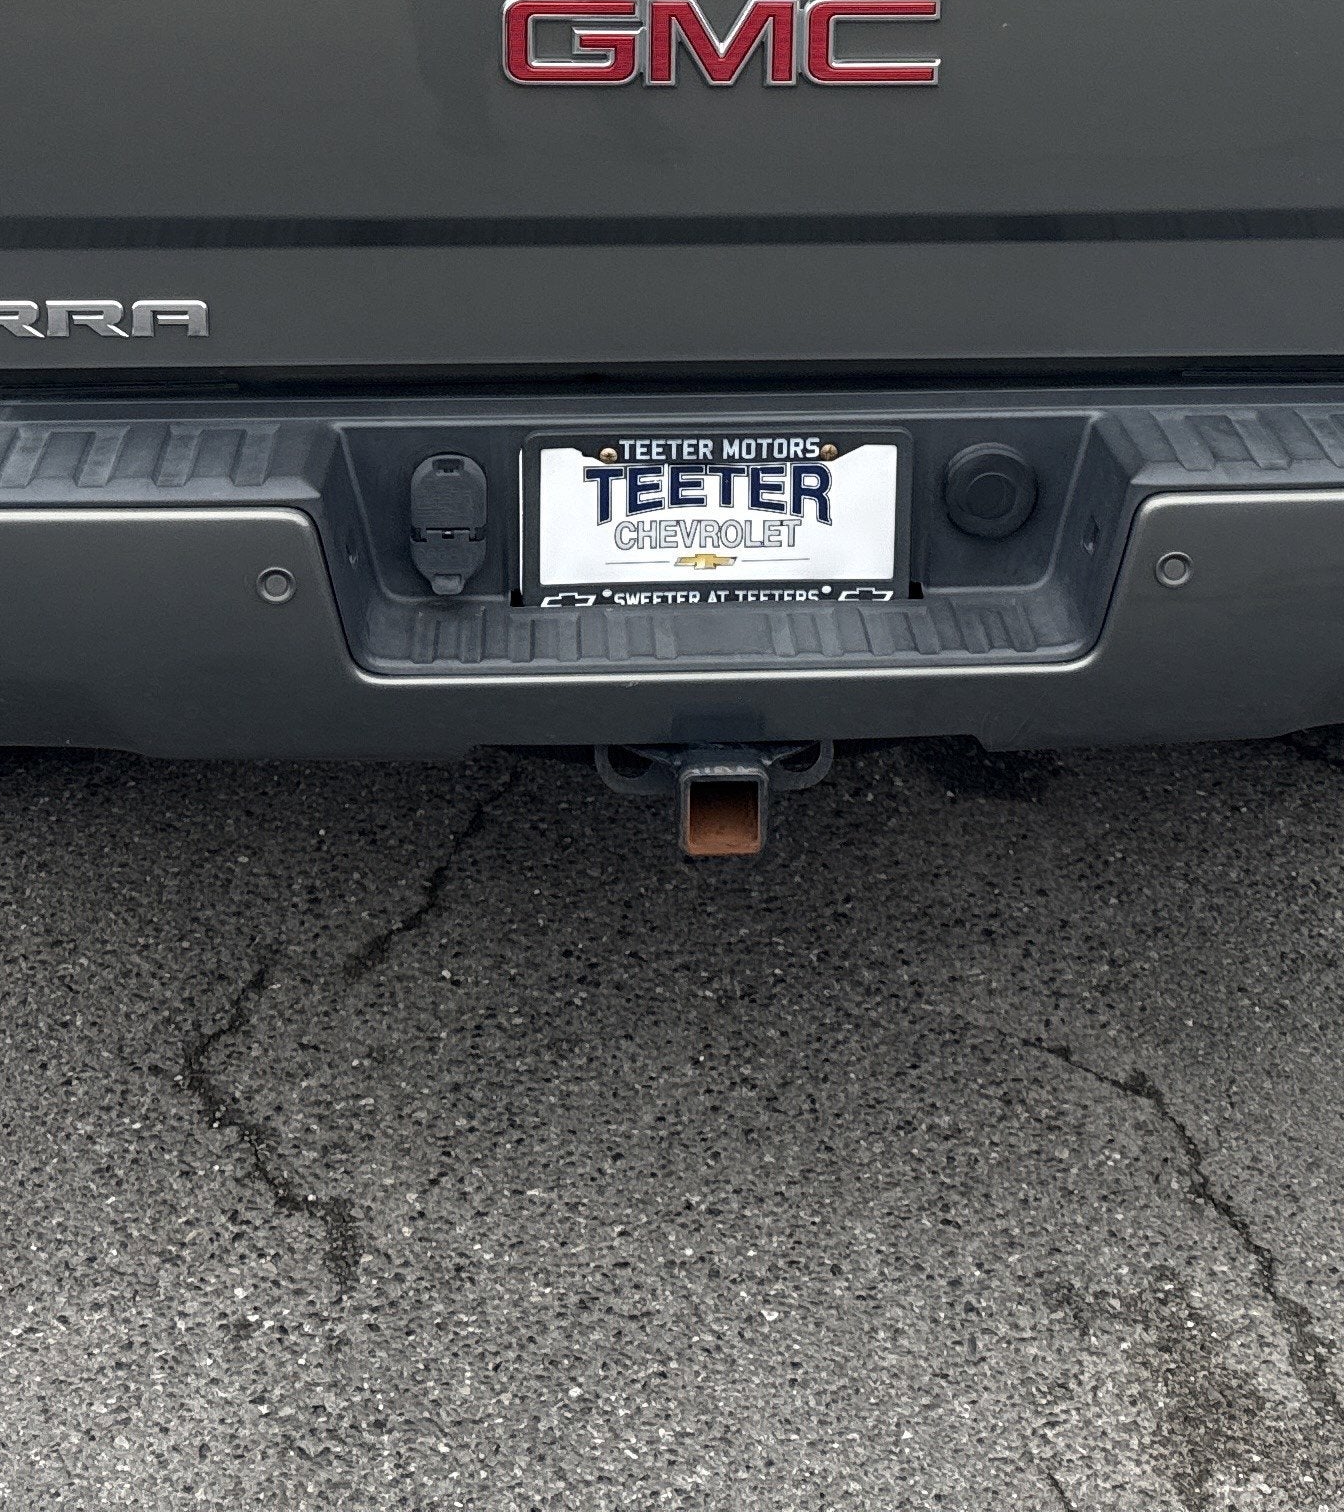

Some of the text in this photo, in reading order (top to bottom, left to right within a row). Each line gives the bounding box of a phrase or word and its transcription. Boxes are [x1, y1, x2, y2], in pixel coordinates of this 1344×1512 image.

[618, 437, 820, 460] TEETER MOTORS
[583, 461, 833, 527] TEETER
[614, 518, 803, 551] CHEVROLET
[707, 590, 730, 604] AT
